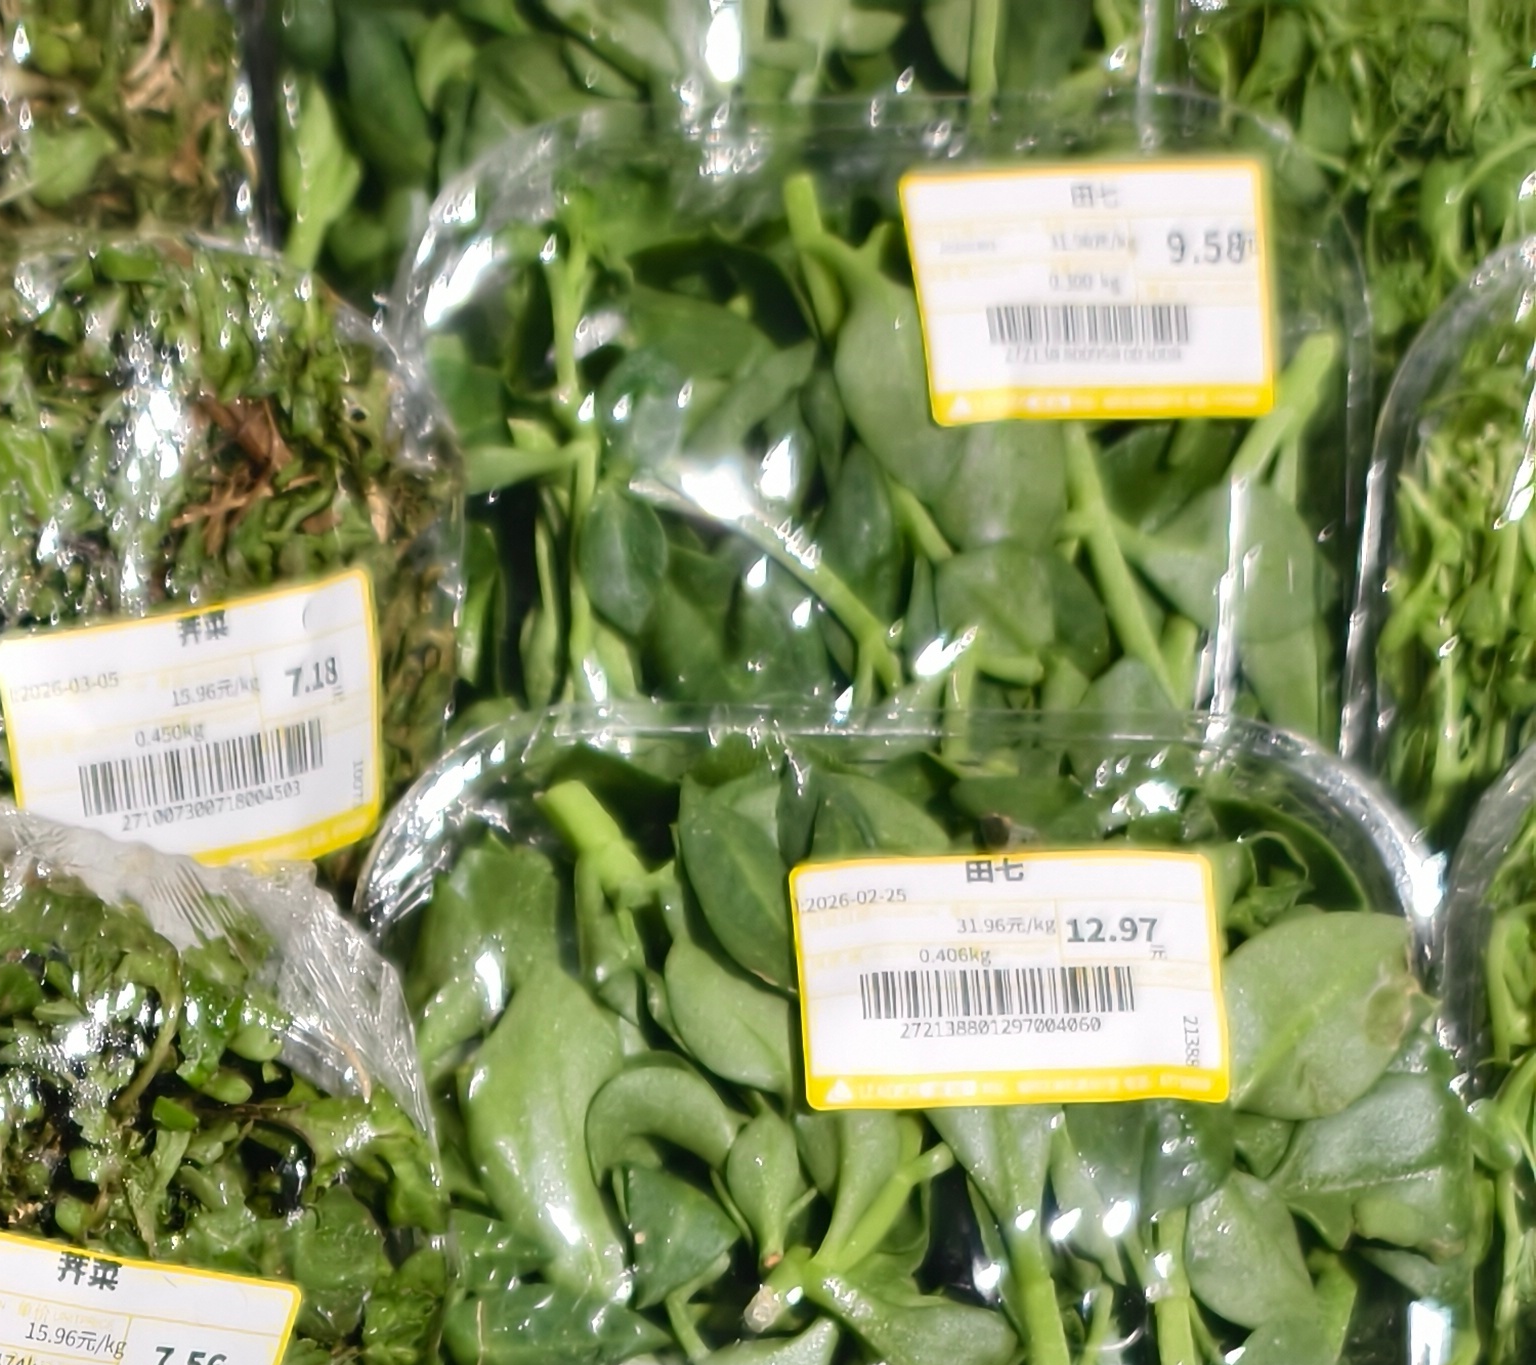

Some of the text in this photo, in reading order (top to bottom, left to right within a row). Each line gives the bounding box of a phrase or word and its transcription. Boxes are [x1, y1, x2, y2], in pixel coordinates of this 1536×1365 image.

[285, 656, 339, 697] 7.18
[135, 721, 204, 748] 0.450kg
[965, 858, 1024, 884] 田七
[957, 916, 1056, 935] 31.96元/kg
[1067, 917, 1158, 944] 12.97
[919, 948, 991, 966] 0.406kg
[900, 1017, 1102, 1039] 272138801297004060
[58, 1250, 123, 1291] 荠菜
[25, 1321, 127, 1359] 15.96元/kg
